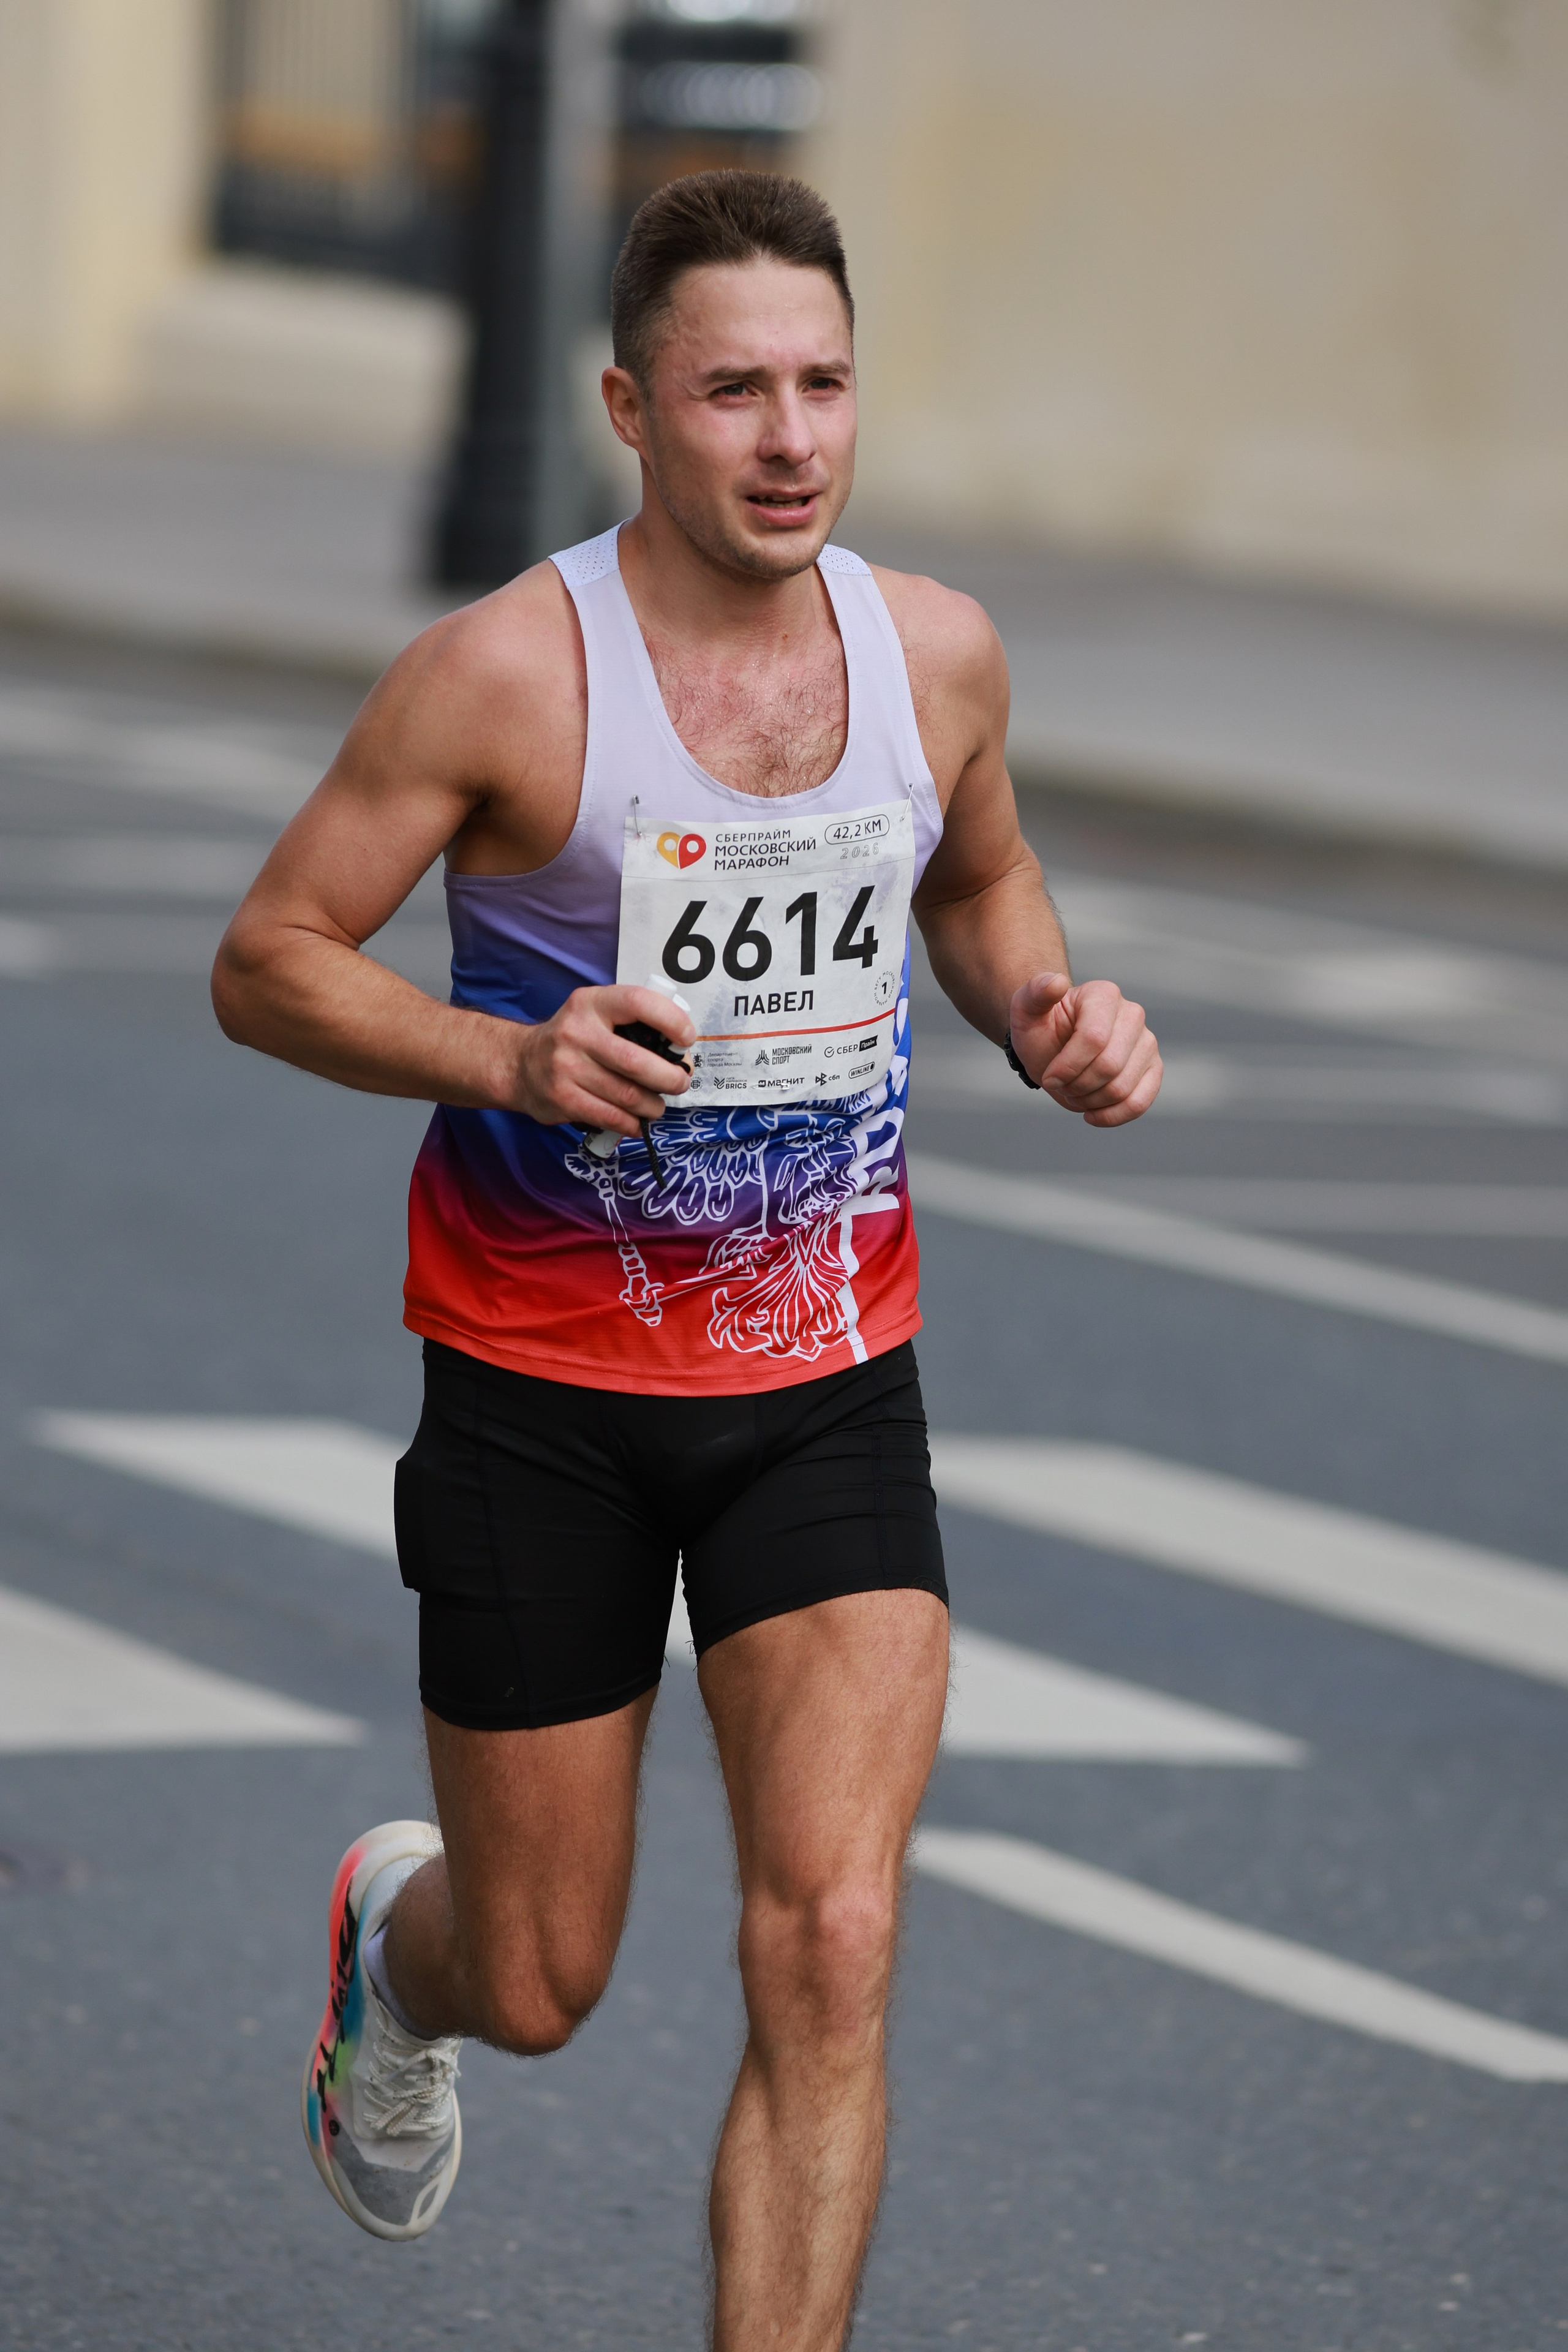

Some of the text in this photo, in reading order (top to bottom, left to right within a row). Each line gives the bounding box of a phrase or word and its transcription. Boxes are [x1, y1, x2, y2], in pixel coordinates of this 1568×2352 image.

[715, 829, 791, 843] СБЕРПРАЙМ
[833, 819, 882, 840] 42,2 КМ
[715, 837, 816, 857] МОСКОВСКИЙ
[840, 842, 880, 859] 2026
[714, 855, 790, 870] МАРАФОН
[662, 885, 879, 984] 6614
[881, 981, 887, 995] 1
[734, 990, 814, 1017] ПАВЕЛ
[772, 1044, 812, 1057] МОСКОВСКИЙ
[837, 1040, 875, 1054] СБЕР Прайм
[772, 1055, 790, 1065] СПОРТ
[851, 1065, 870, 1077] WINLINE
